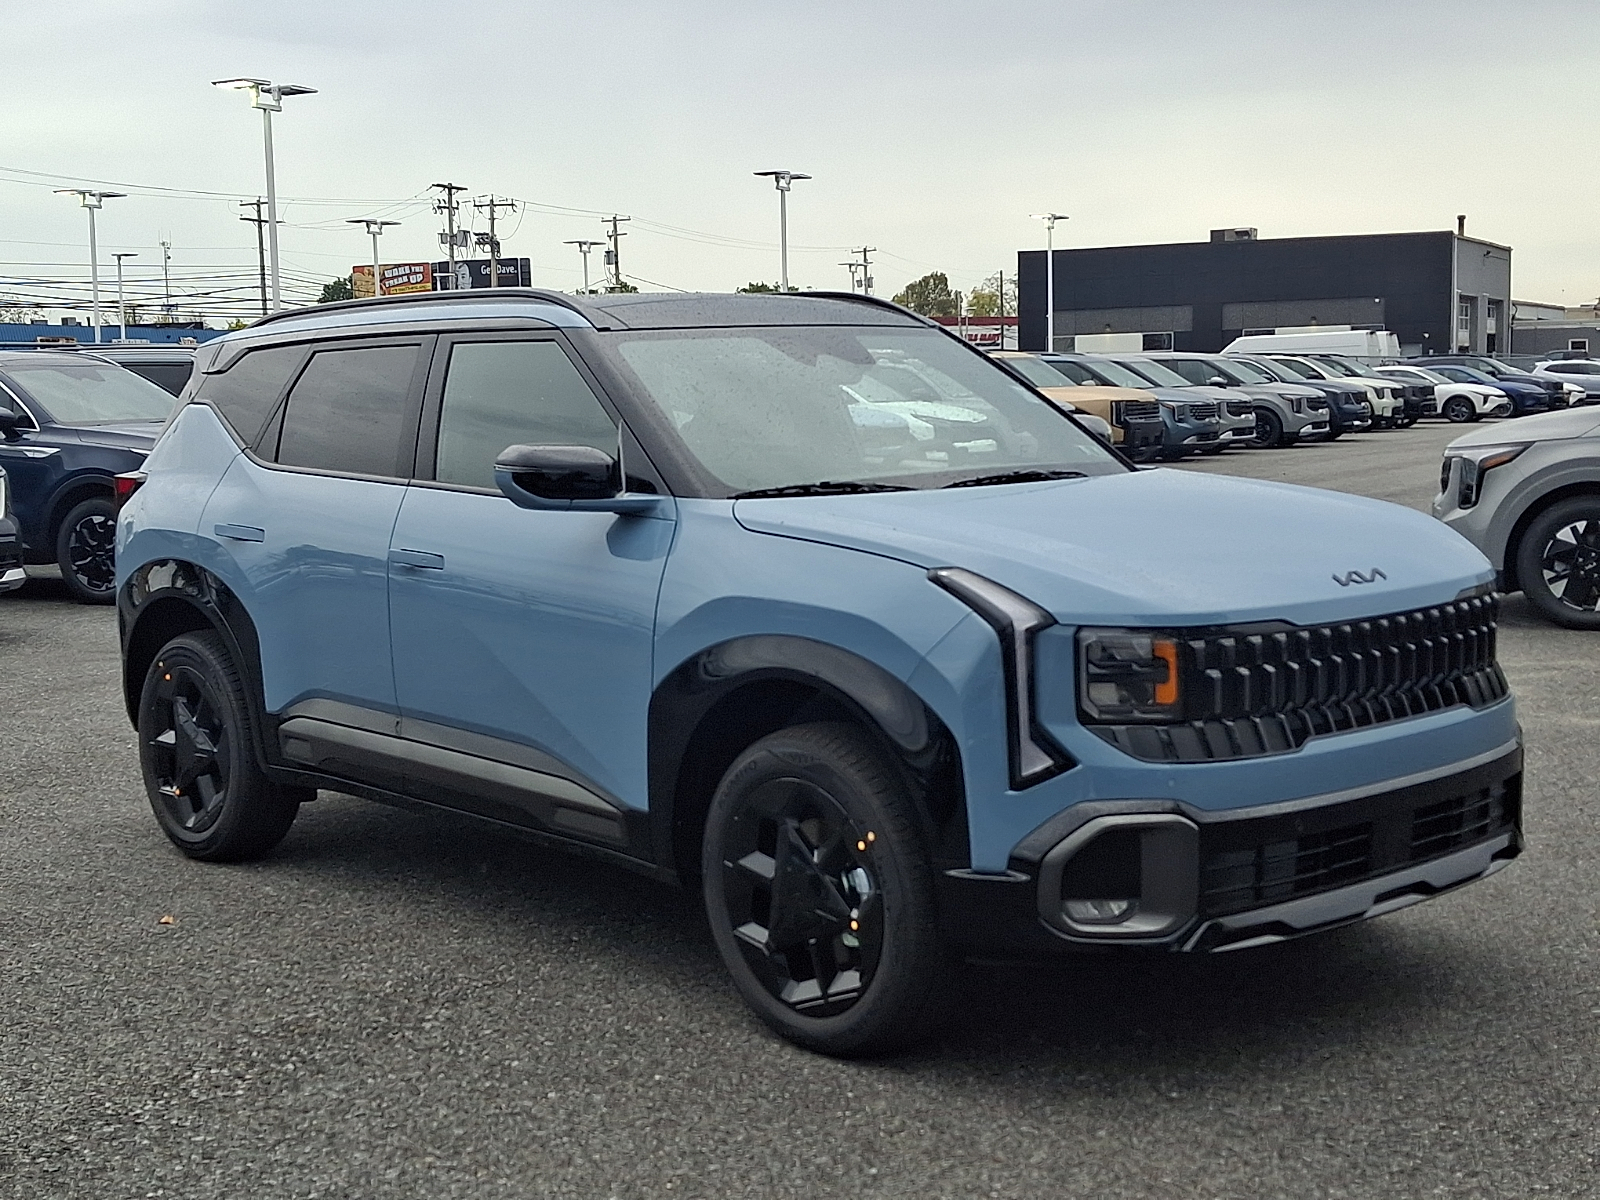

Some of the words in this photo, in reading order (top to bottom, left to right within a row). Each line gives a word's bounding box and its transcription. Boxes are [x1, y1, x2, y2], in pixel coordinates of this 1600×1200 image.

[384, 265, 410, 278] WAKE
[497, 264, 518, 274] Dave.
[410, 273, 424, 284] UP
